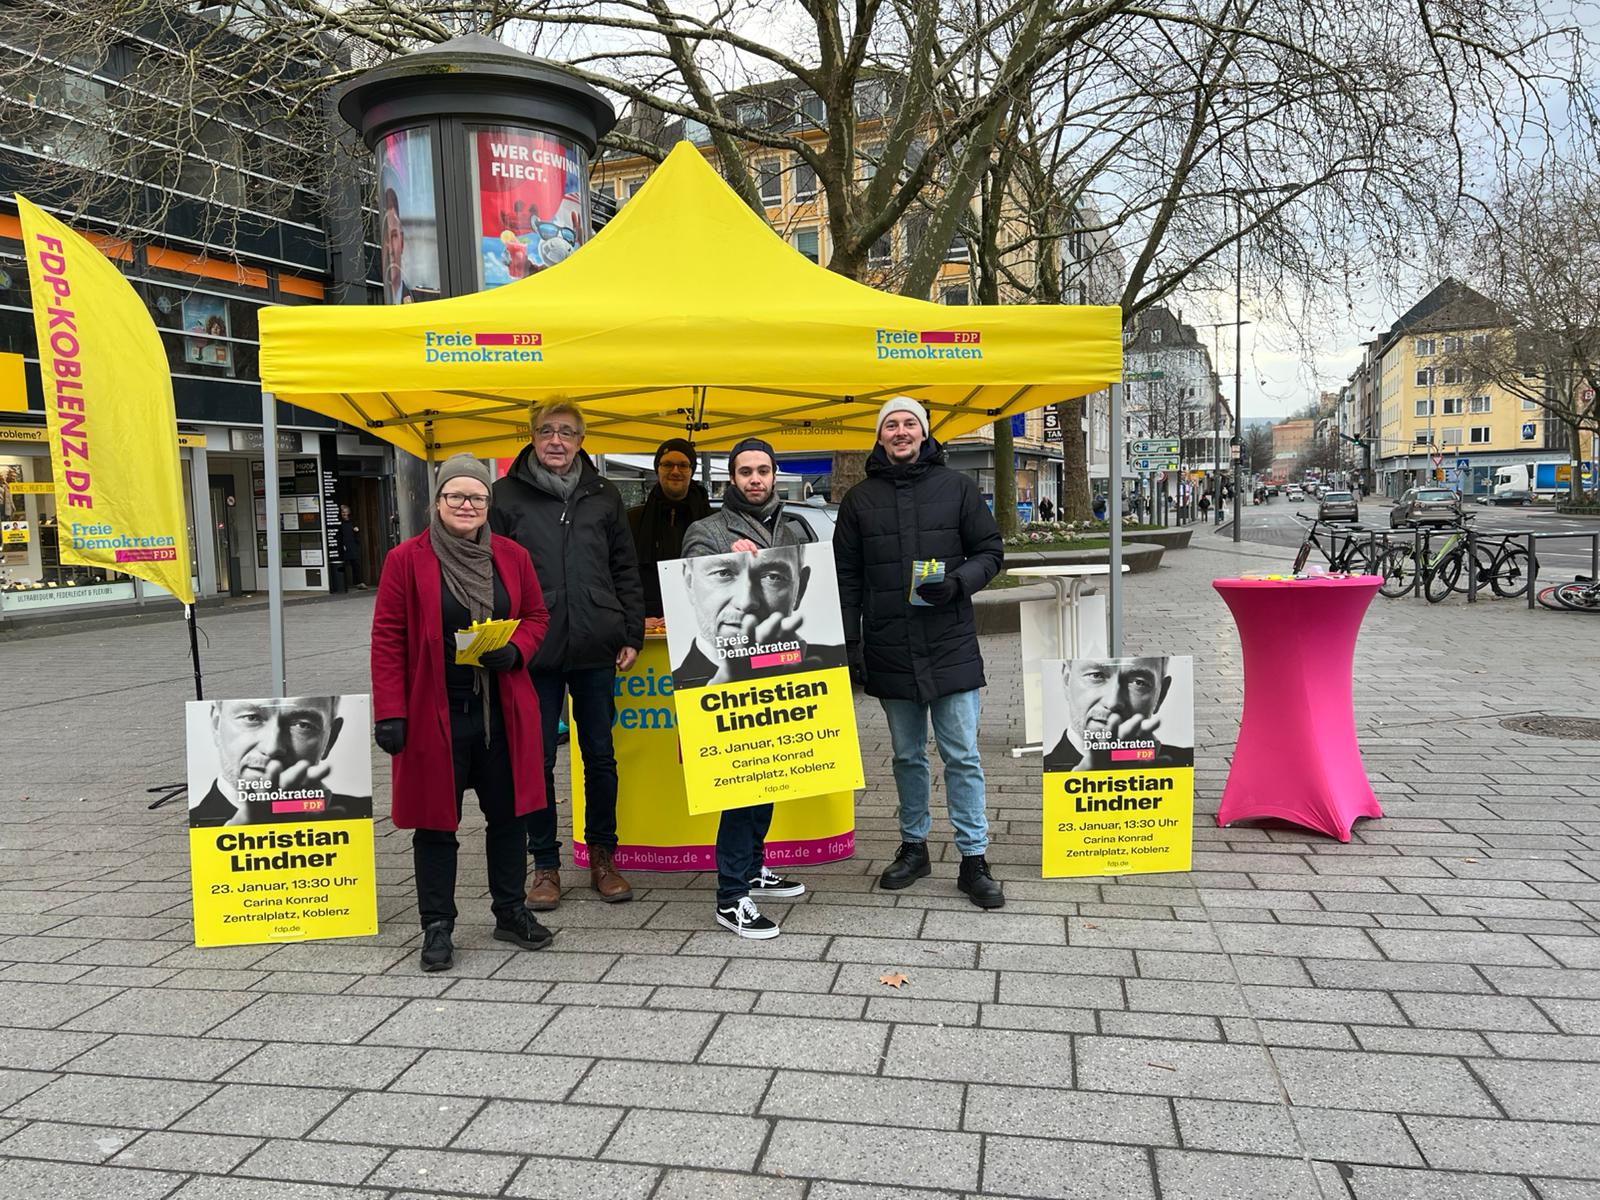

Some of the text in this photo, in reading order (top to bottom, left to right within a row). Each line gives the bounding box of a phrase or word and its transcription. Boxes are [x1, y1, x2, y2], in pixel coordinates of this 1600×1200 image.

[491, 143, 529, 161] WER
[491, 162, 547, 182] FLIEGT.
[425, 332, 539, 346] Freie FDP
[876, 329, 978, 344] Freie FDP
[425, 347, 543, 362] Demokraten
[877, 345, 983, 359] Demokraten
[36, 233, 93, 510] FDP-KOBLENZ.DE
[72, 522, 112, 536] Freie
[72, 534, 175, 549] Demokraten
[153, 550, 175, 560] FDP
[715, 633, 749, 648] Freie
[717, 639, 801, 660] Demokraten
[779, 652, 800, 663] FDP
[613, 667, 674, 697] reie
[700, 680, 828, 712] Christian
[716, 703, 818, 733] Lindner
[1083, 729, 1112, 740] Freie
[699, 728, 841, 758] 23. Januar, 13:30 Uhr
[1083, 738, 1155, 750] Demokraten
[731, 748, 814, 769] Carina Konrad
[1136, 751, 1154, 759] FDP
[714, 761, 836, 787] Zentralplatz, Koblenz
[237, 778, 272, 790] Freie
[764, 783, 790, 793] fdp.de
[1064, 775, 1174, 794] Christian
[237, 788, 325, 802] Demokraten
[303, 801, 323, 810] FDP
[1075, 795, 1163, 812] Lindner
[1058, 818, 1179, 832] 23. Januar, 13:30 Uhr
[216, 828, 350, 851] Christian
[1083, 833, 1154, 845] Carina Konrad
[615, 851, 698, 864] dp-koblenz.de
[765, 846, 810, 859] lenz.de
[1066, 846, 1170, 858] Zentralplatz, Koblenz
[231, 851, 337, 873] Lindner
[1107, 860, 1129, 868] fdp.de
[211, 876, 359, 895] 23. Januar, 13:30 Uhr
[243, 894, 329, 908] Carina Konrad
[223, 907, 350, 924] Zentralplatz, Koblenz
[274, 925, 301, 934] fdp.de
